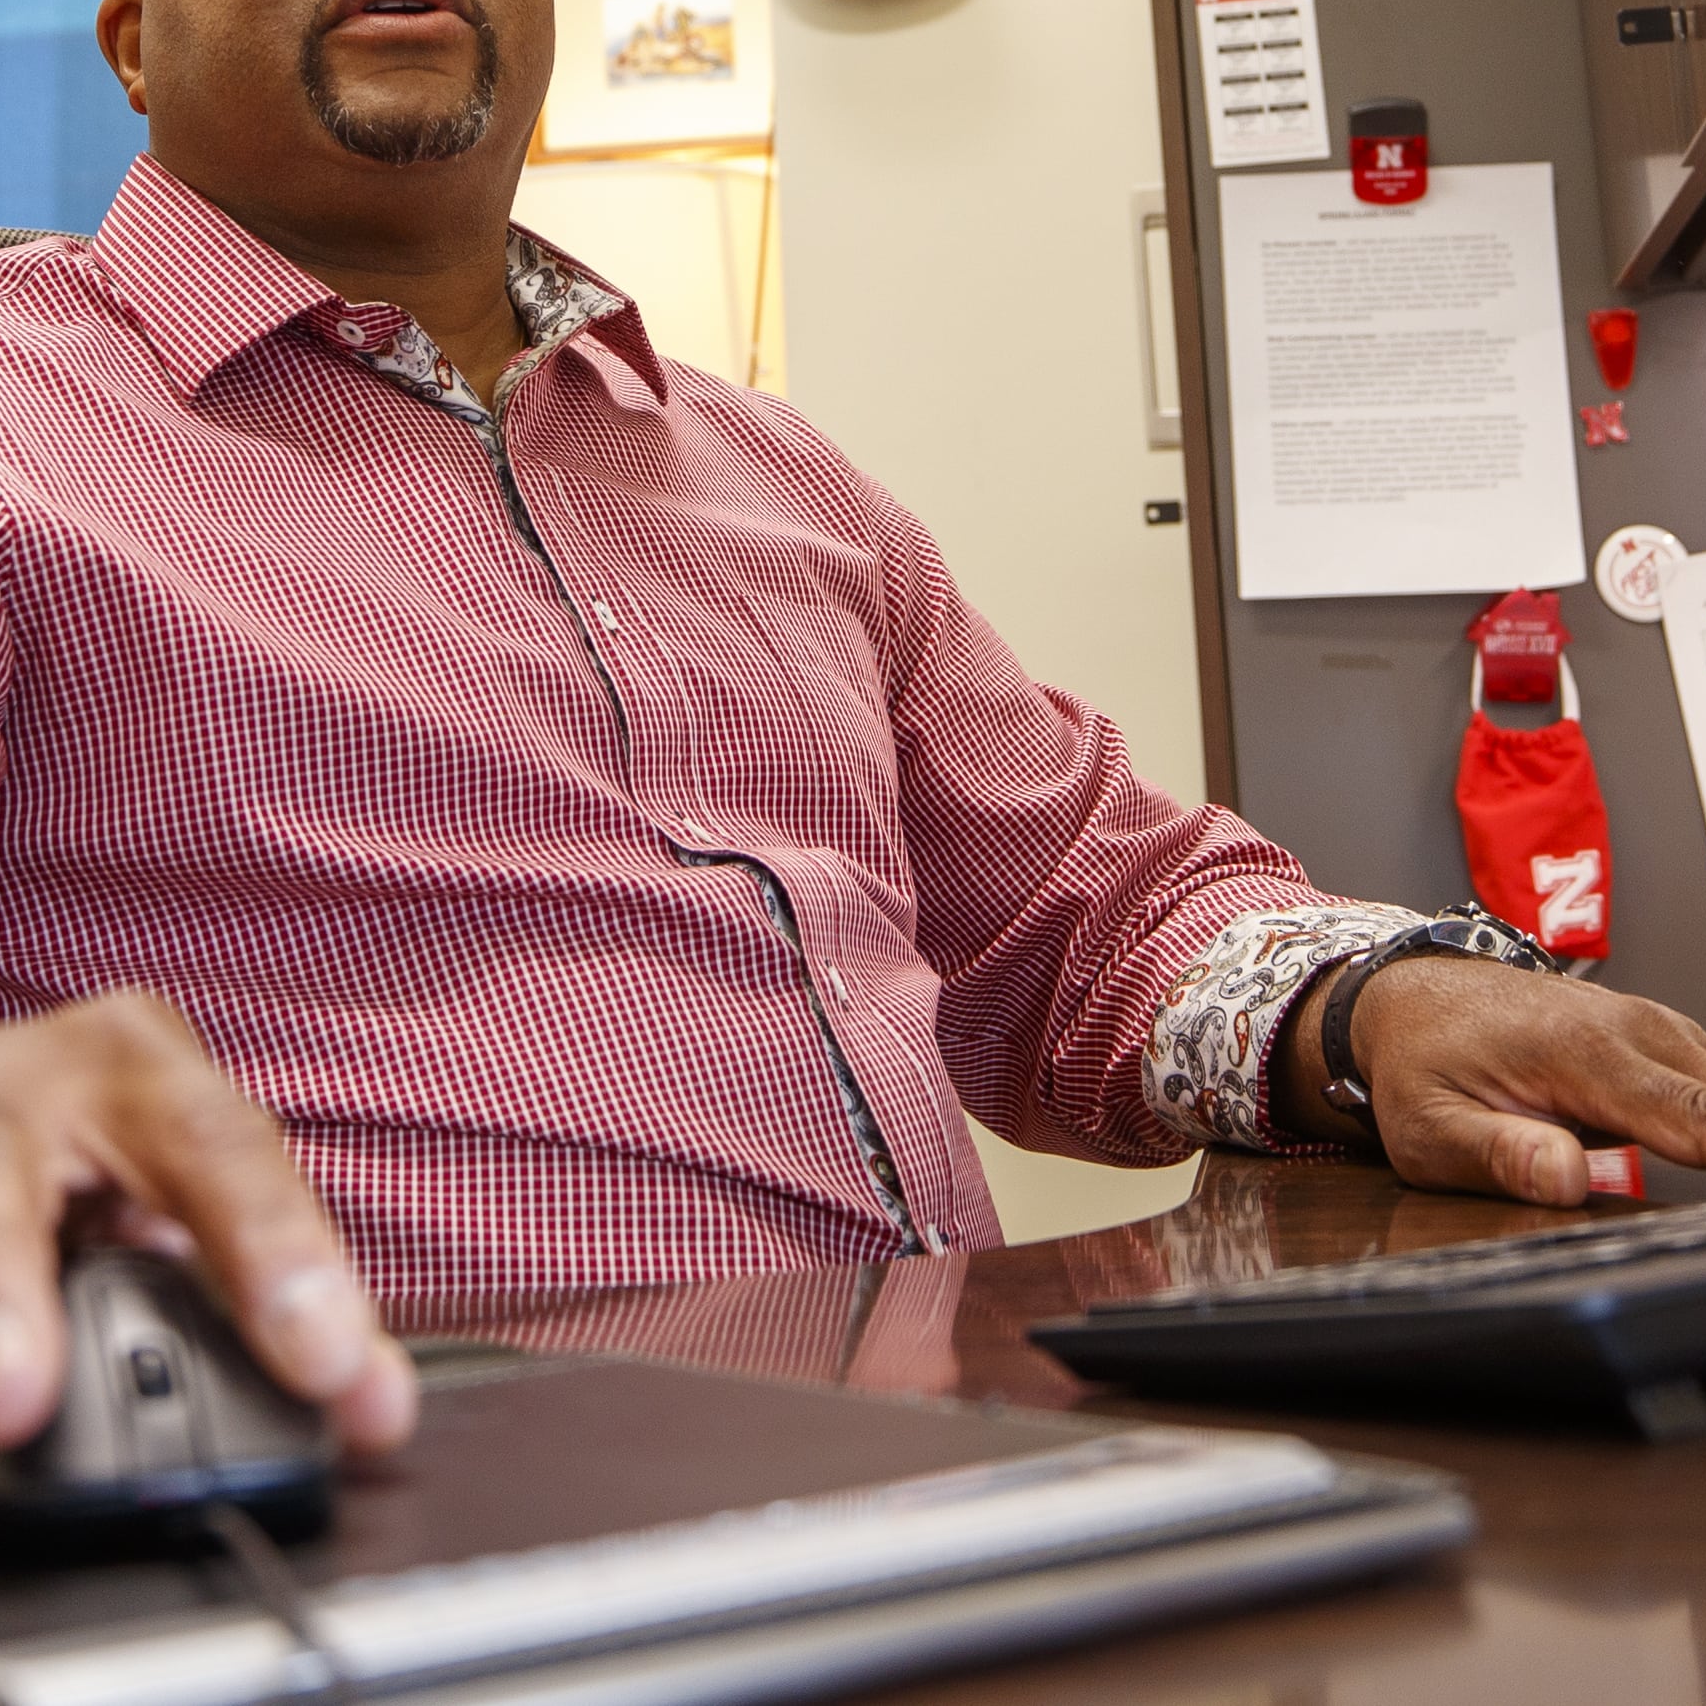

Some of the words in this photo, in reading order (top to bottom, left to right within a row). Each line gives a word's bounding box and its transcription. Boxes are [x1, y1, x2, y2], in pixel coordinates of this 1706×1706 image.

[1375, 143, 1405, 168] N
[1580, 401, 1630, 448] N
[1529, 847, 1605, 946] N
